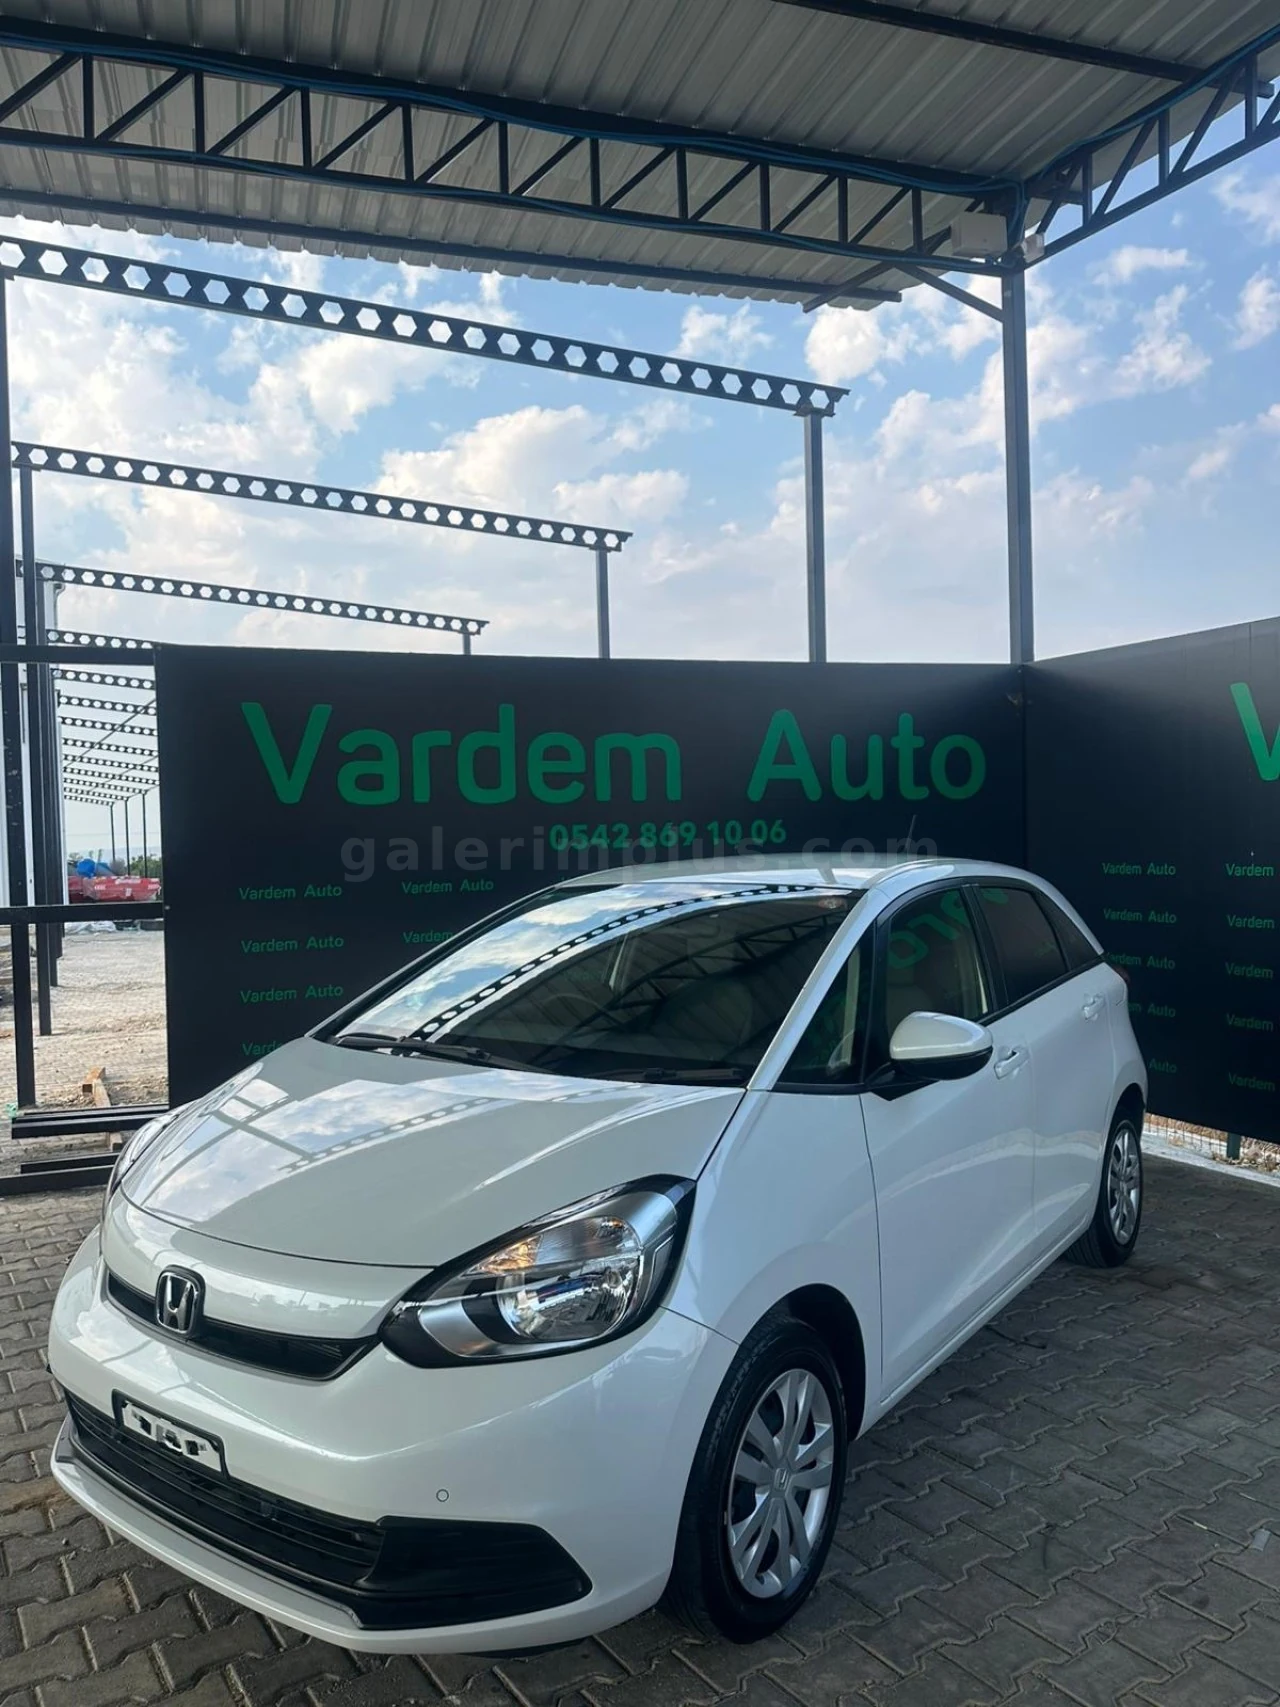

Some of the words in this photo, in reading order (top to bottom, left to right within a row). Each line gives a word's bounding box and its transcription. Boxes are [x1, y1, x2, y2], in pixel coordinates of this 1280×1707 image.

[241, 702, 682, 806] Vardem
[747, 709, 986, 802] Auto
[549, 823, 630, 851] 0542
[640, 821, 696, 848] 869
[707, 820, 743, 846] 10
[750, 819, 787, 844] 06
[1101, 862, 1141, 875] Vardem
[1147, 862, 1176, 875] Auto
[1225, 863, 1274, 877] Vardem
[239, 886, 296, 900] Vardem
[304, 884, 342, 897] Auto
[402, 880, 452, 895] Vardem
[460, 879, 494, 892] Auto
[1103, 908, 1142, 921] Vardem
[1148, 909, 1177, 923] Auto
[1227, 914, 1275, 929] Vardem
[240, 938, 298, 953] Vardem
[306, 936, 344, 950] Auto
[1147, 955, 1176, 970] Auto
[1225, 961, 1273, 980] Vardem
[240, 988, 297, 1003] Vardem
[305, 985, 344, 999] Auto
[1147, 1002, 1176, 1018] Auto
[1226, 1012, 1274, 1032] Vardem
[1149, 1058, 1177, 1074] Auto
[1228, 1071, 1276, 1092] Vardem
